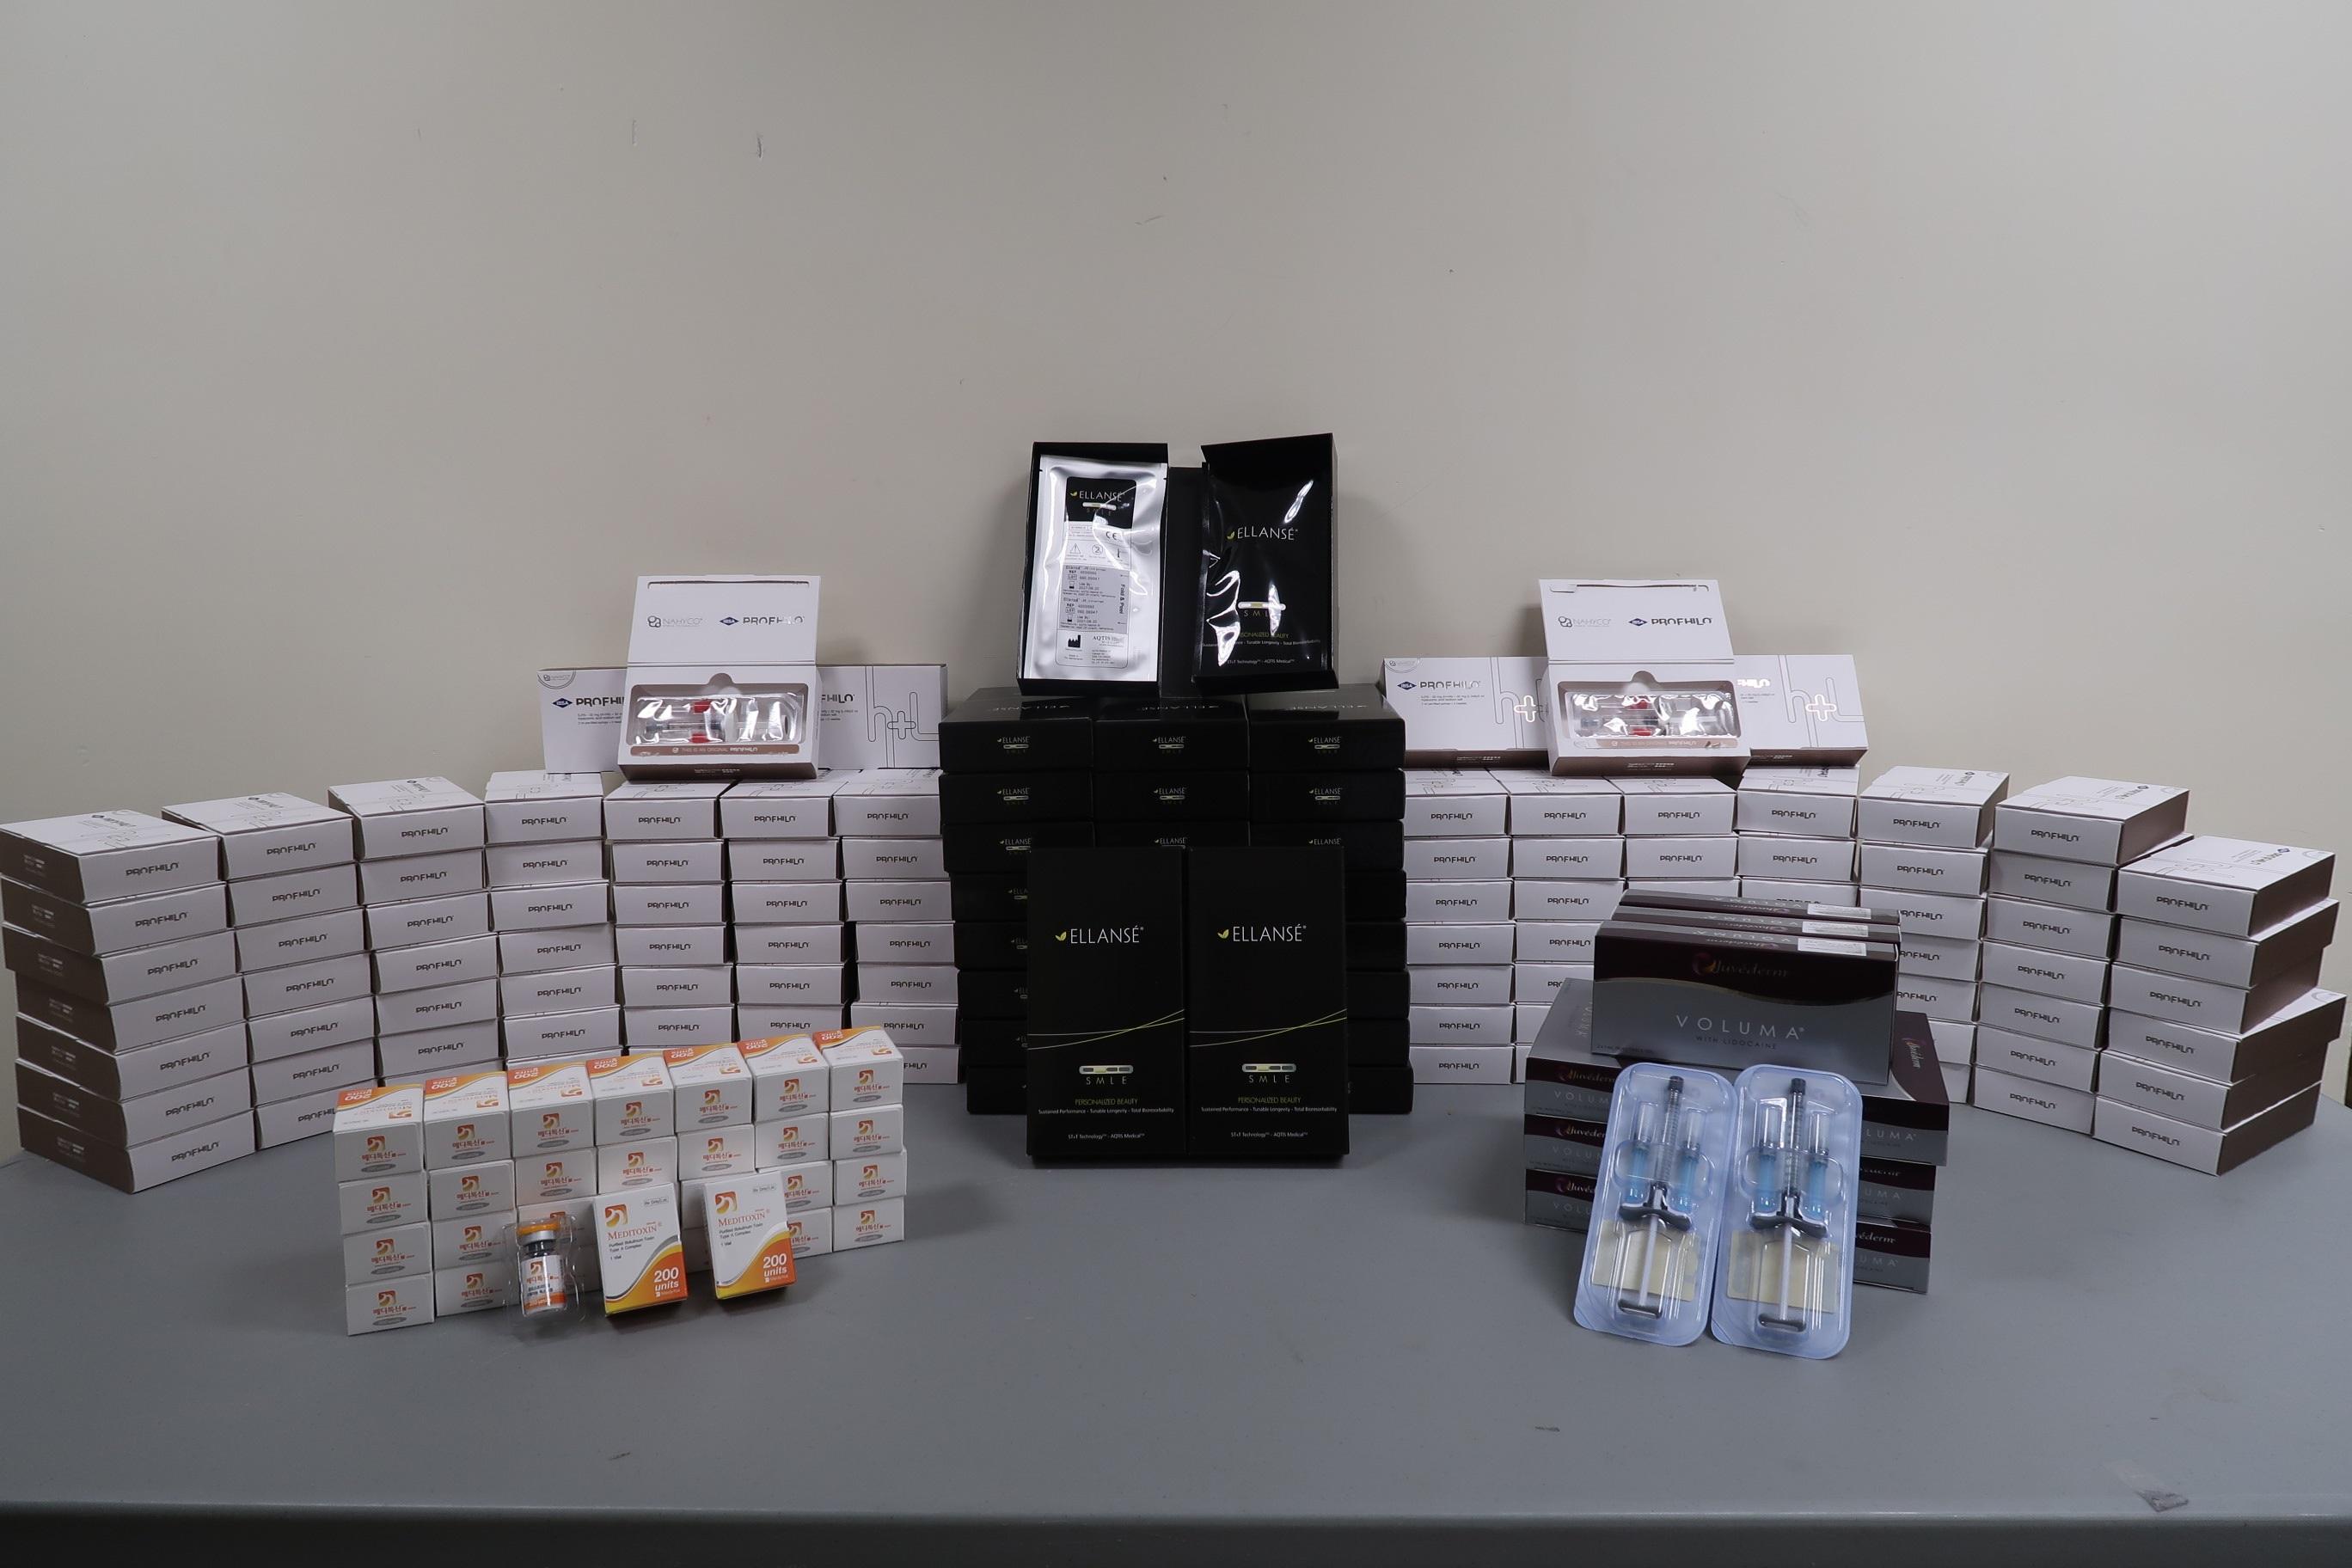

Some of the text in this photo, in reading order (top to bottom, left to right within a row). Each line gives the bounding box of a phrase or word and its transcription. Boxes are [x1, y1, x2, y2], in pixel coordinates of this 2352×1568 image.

[1238, 525, 1296, 541] ELLANSÉ
[1651, 617, 1712, 626] PROFHILO
[1420, 681, 1480, 689] PROFHILO
[576, 697, 624, 707] PROFHI
[753, 814, 798, 824] PROFHILO
[867, 812, 910, 821] PROFHILO
[1430, 812, 1474, 821] PROFHILO
[1543, 812, 1588, 820] PROFHILO
[1657, 811, 1700, 819] PROFHILO
[1771, 809, 1816, 819] PROFHILO
[521, 816, 568, 826] PROFHILO
[638, 816, 683, 825] PROFHILO
[1892, 818, 1942, 830] PROFHILO
[401, 826, 449, 838] PROFHILO
[2030, 829, 2081, 842] PROFHILO
[266, 842, 317, 856] PROFHILO
[522, 859, 569, 870] PROFHILO
[763, 857, 805, 866] PROFHILO
[875, 854, 919, 864] PROFHILO
[1433, 855, 1478, 865] PROFHILO
[1659, 854, 1704, 863] PROFHILO
[1772, 854, 1818, 865] PROFHILO
[125, 861, 180, 877] PROFHILO
[1896, 865, 1945, 876] PROFHILO
[400, 871, 448, 883] PROFHILO
[2024, 873, 2073, 888] PROFHILO
[271, 888, 321, 902] PROFHILO
[1547, 897, 1590, 906] PROFHILO
[2155, 896, 2210, 911] PROFHILO
[134, 911, 189, 928] PROFHILO
[1070, 926, 1140, 944] ELLANSÉ
[1233, 924, 1303, 942] ELLANSÉ
[536, 943, 582, 955] PROFHILO
[648, 942, 693, 951] PROFHILO
[889, 940, 932, 948] PROFHILO
[1438, 941, 1482, 950] PROFHILO
[1548, 939, 1591, 948] PROFHILO
[1900, 950, 1941, 961] ROFHILO
[2158, 945, 2211, 961] PROFHILO
[147, 958, 199, 976] PROFHILO
[415, 959, 462, 971] PROFHILO
[2017, 965, 2066, 981] PROFHILO
[285, 977, 335, 993] PROFHILO
[1897, 991, 1938, 1002] ROFHILO
[2149, 991, 2203, 1008] PROFHILO
[2014, 1008, 2061, 1024] PROFHILO
[769, 1020, 812, 1030] PROFHILO
[884, 1022, 925, 1031] PROFHILO
[1438, 1022, 1482, 1031] PROFHILO
[1676, 1015, 1799, 1040] VOLUMA
[541, 1028, 586, 1039] PROFHILO
[417, 1041, 465, 1056] PROFHILO
[1697, 1035, 1777, 1050] WITH LIDOCAINE
[159, 1051, 211, 1071] PROFHILO
[903, 1062, 928, 1070] FHILO
[1438, 1061, 1479, 1070] PROFHILO
[291, 1063, 340, 1080] PROFHILO
[2135, 1081, 2185, 1101] PROFHILO
[1553, 1090, 1611, 1105] VOLUM
[2009, 1093, 2056, 1110] PROFHILO
[297, 1108, 335, 1122] PROFHIL
[1866, 1128, 1914, 1142] LUMA
[2131, 1126, 2181, 1147] PROFHILO
[170, 1141, 219, 1162] PROFHILO
[718, 1212, 765, 1228] MEDITOXIN
[608, 1224, 657, 1240] MEDITOXIN
[763, 1253, 787, 1269] 200
[654, 1267, 679, 1283] 200
[763, 1266, 787, 1277] units
[654, 1280, 679, 1292] units
